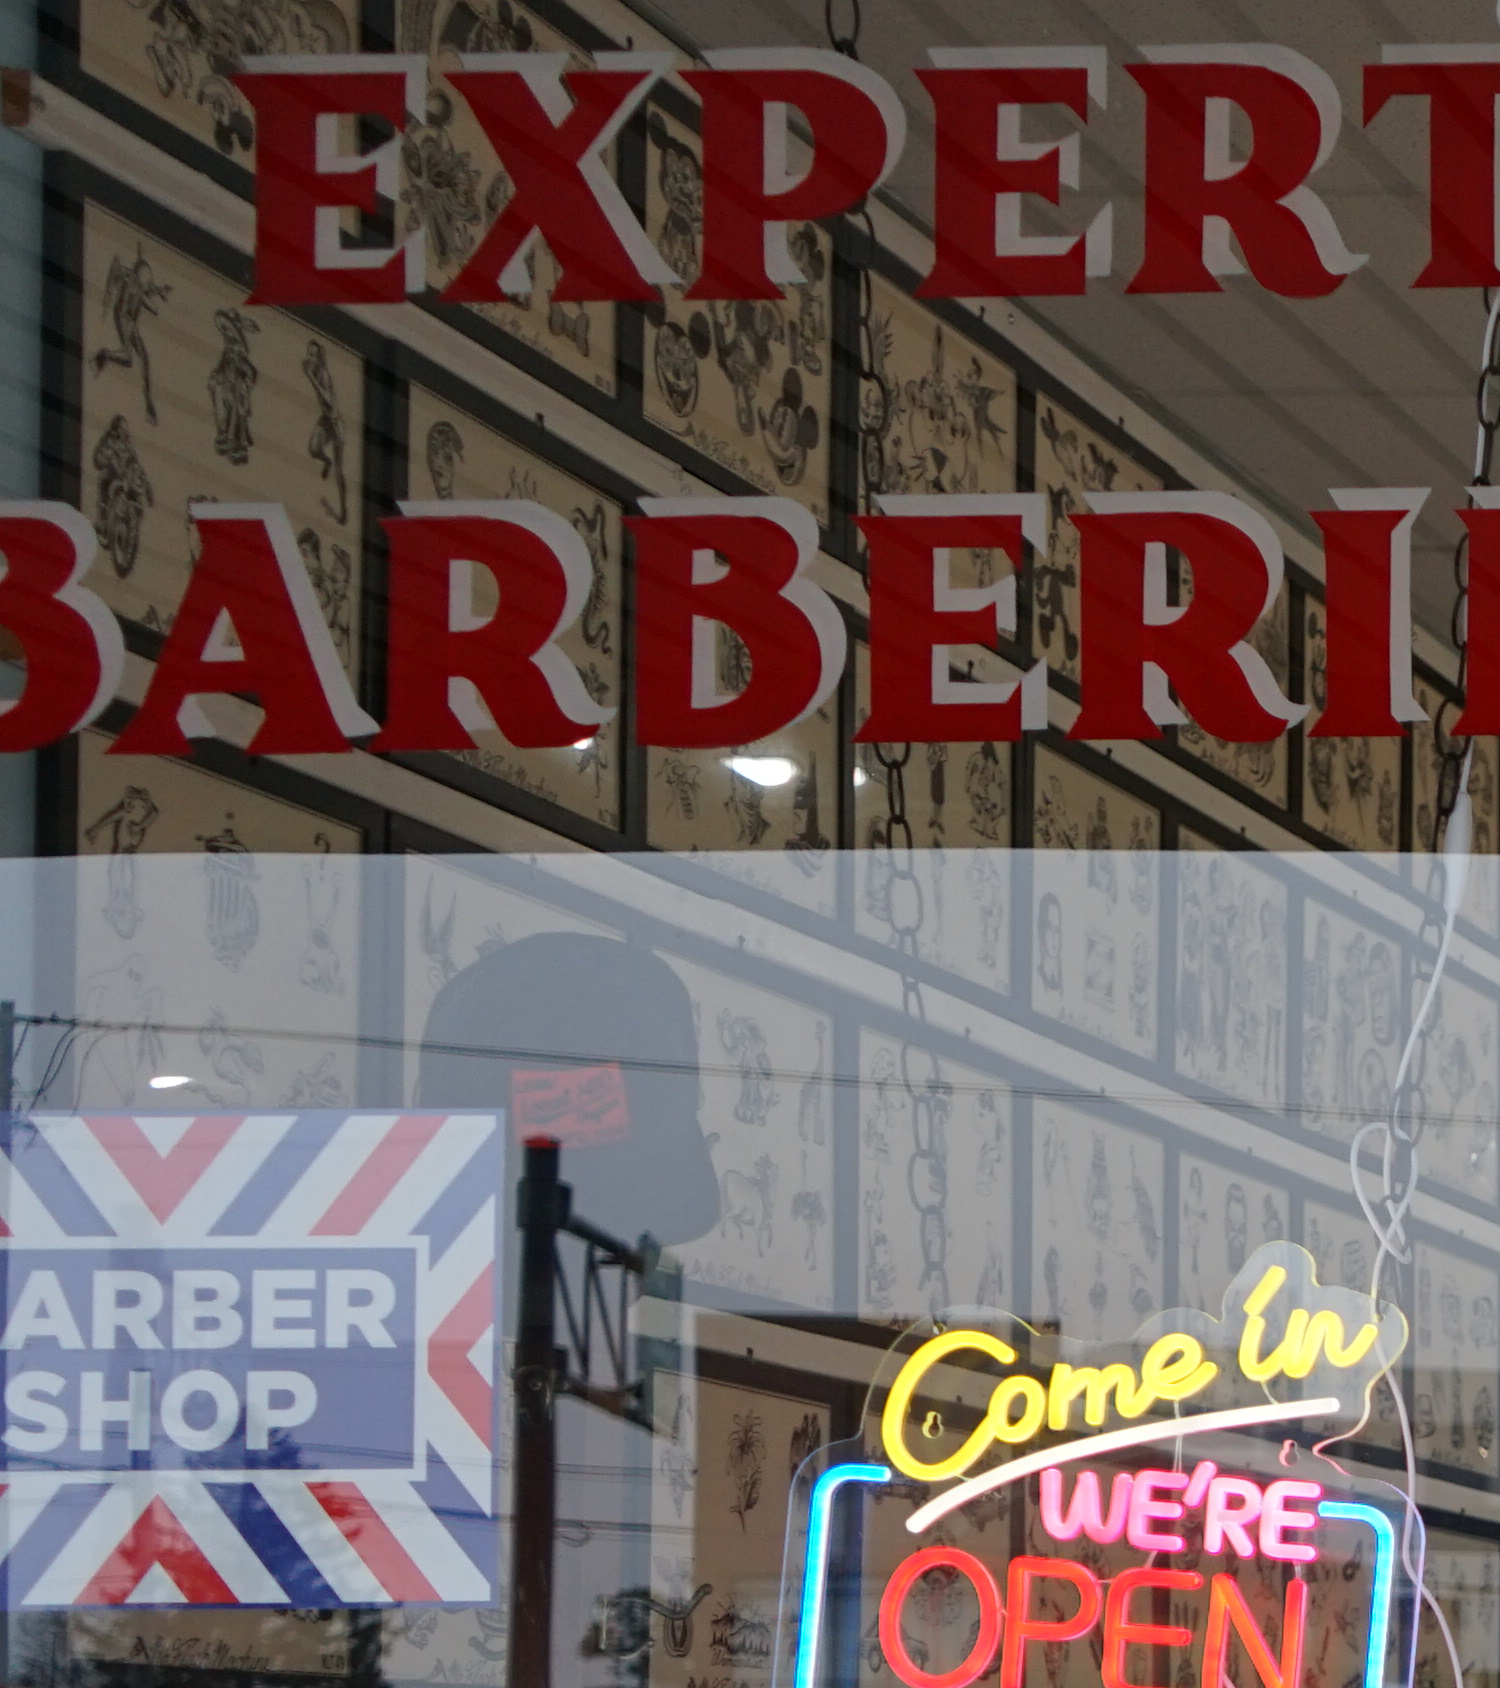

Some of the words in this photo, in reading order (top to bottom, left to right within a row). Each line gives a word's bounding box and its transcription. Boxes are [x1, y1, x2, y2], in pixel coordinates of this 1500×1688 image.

[1, 1369, 318, 1453] SHOP
[882, 1329, 1217, 1482] Come
[1238, 1265, 1378, 1381] in
[1038, 1461, 1323, 1562] WE'RE
